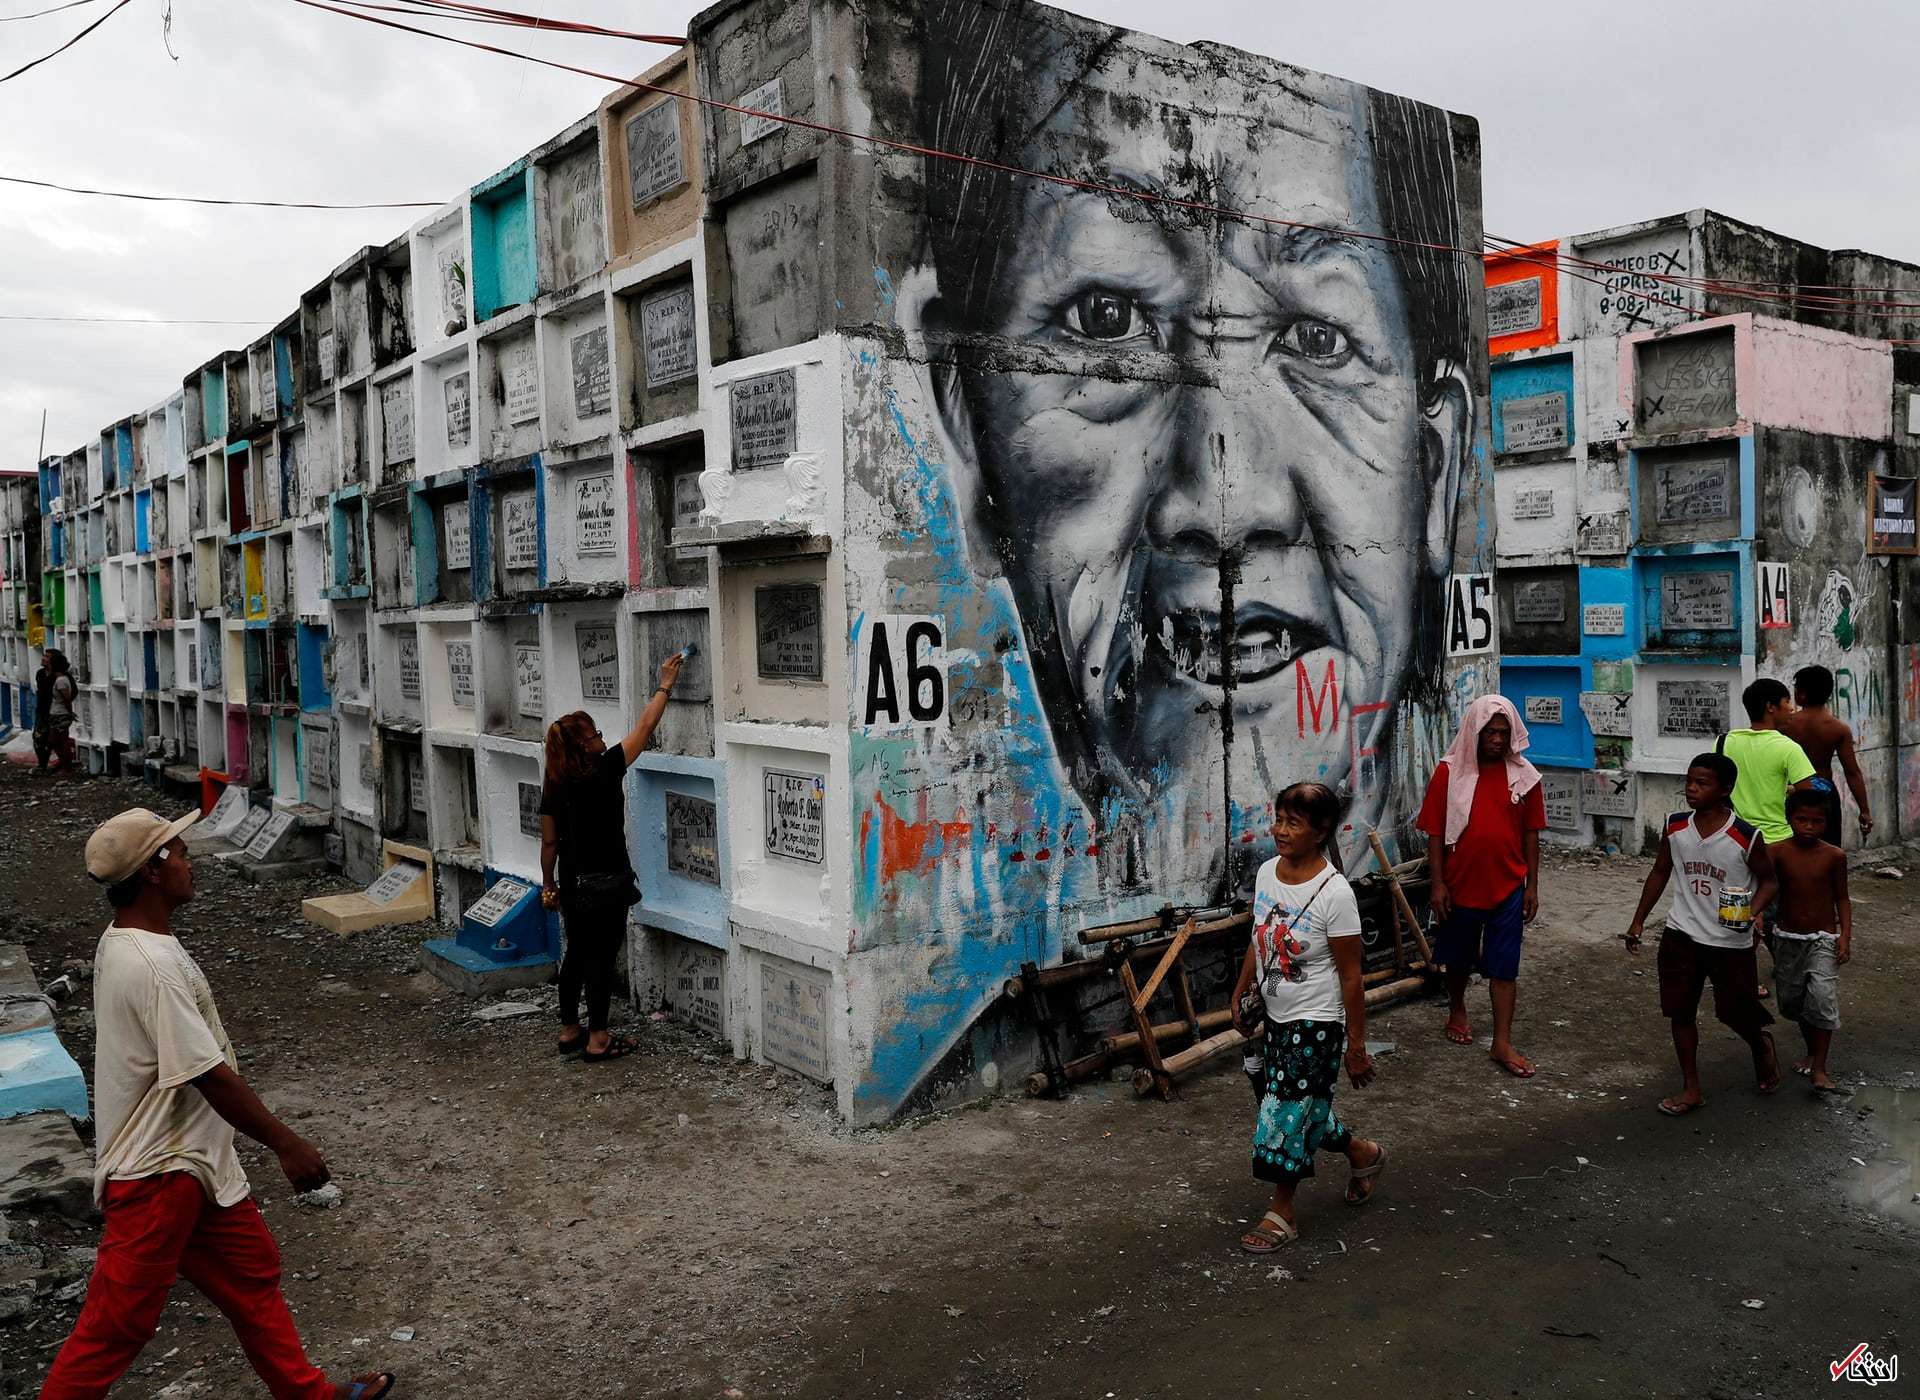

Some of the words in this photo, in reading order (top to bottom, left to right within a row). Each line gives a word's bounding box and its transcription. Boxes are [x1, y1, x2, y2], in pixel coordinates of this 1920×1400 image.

[754, 383, 774, 395] R.I.P.
[1451, 577, 1491, 651] A5
[1761, 566, 1788, 624] A4
[865, 622, 943, 724] A6
[1296, 657, 1338, 739] M
[1691, 879, 1711, 896] 15
